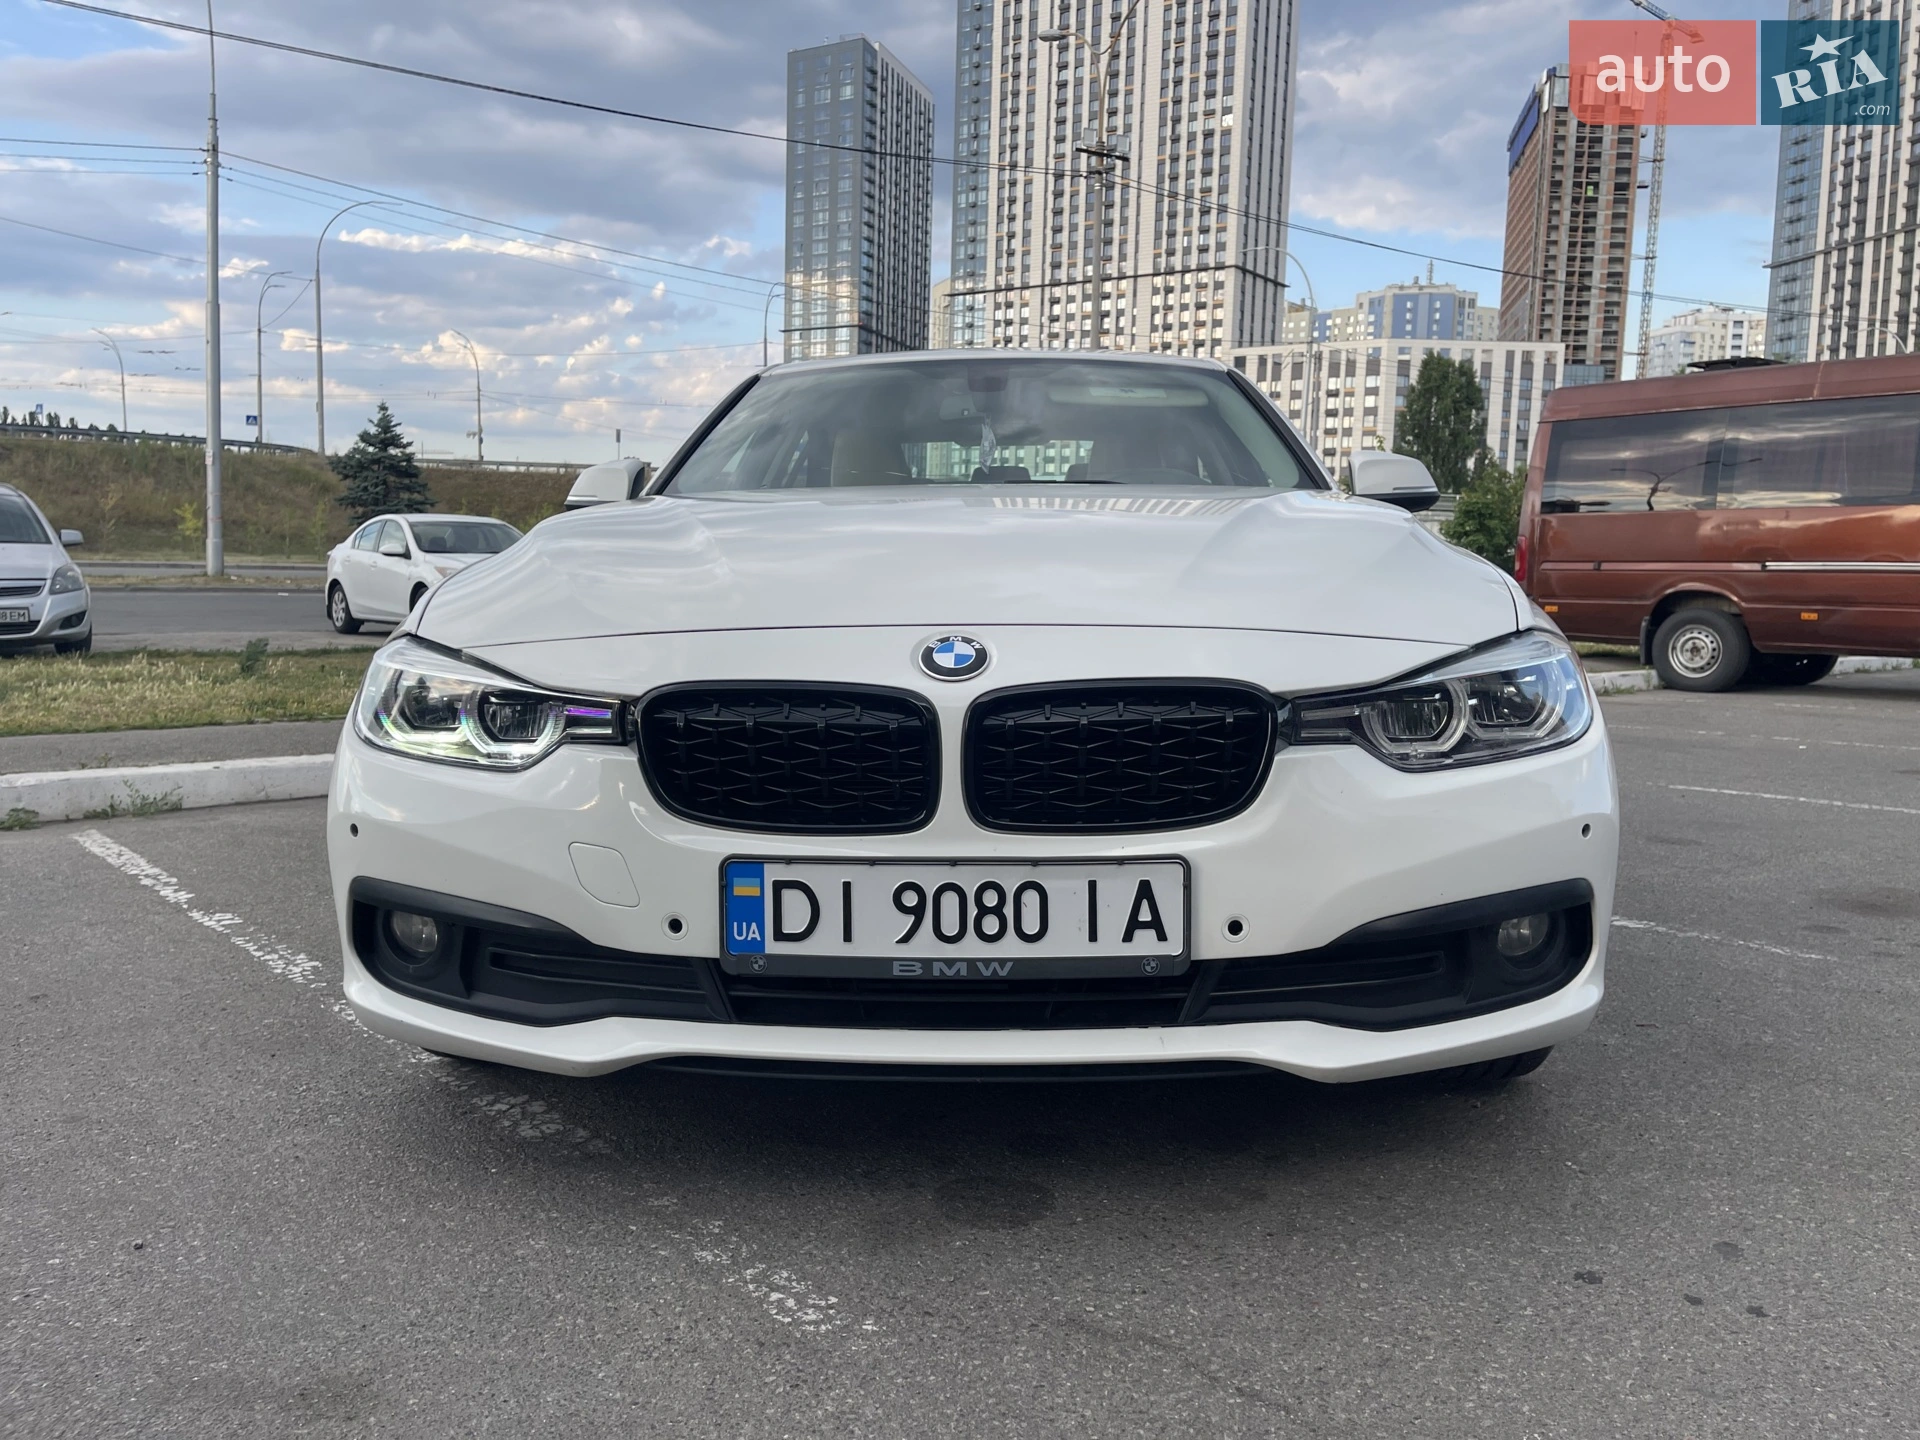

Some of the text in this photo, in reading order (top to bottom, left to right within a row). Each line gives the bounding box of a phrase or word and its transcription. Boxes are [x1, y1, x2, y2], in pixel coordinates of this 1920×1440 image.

[928, 636, 983, 649] BMW
[772, 879, 1168, 944] DI 9080 IA
[733, 922, 761, 941] UA
[892, 961, 1013, 977] BMW
